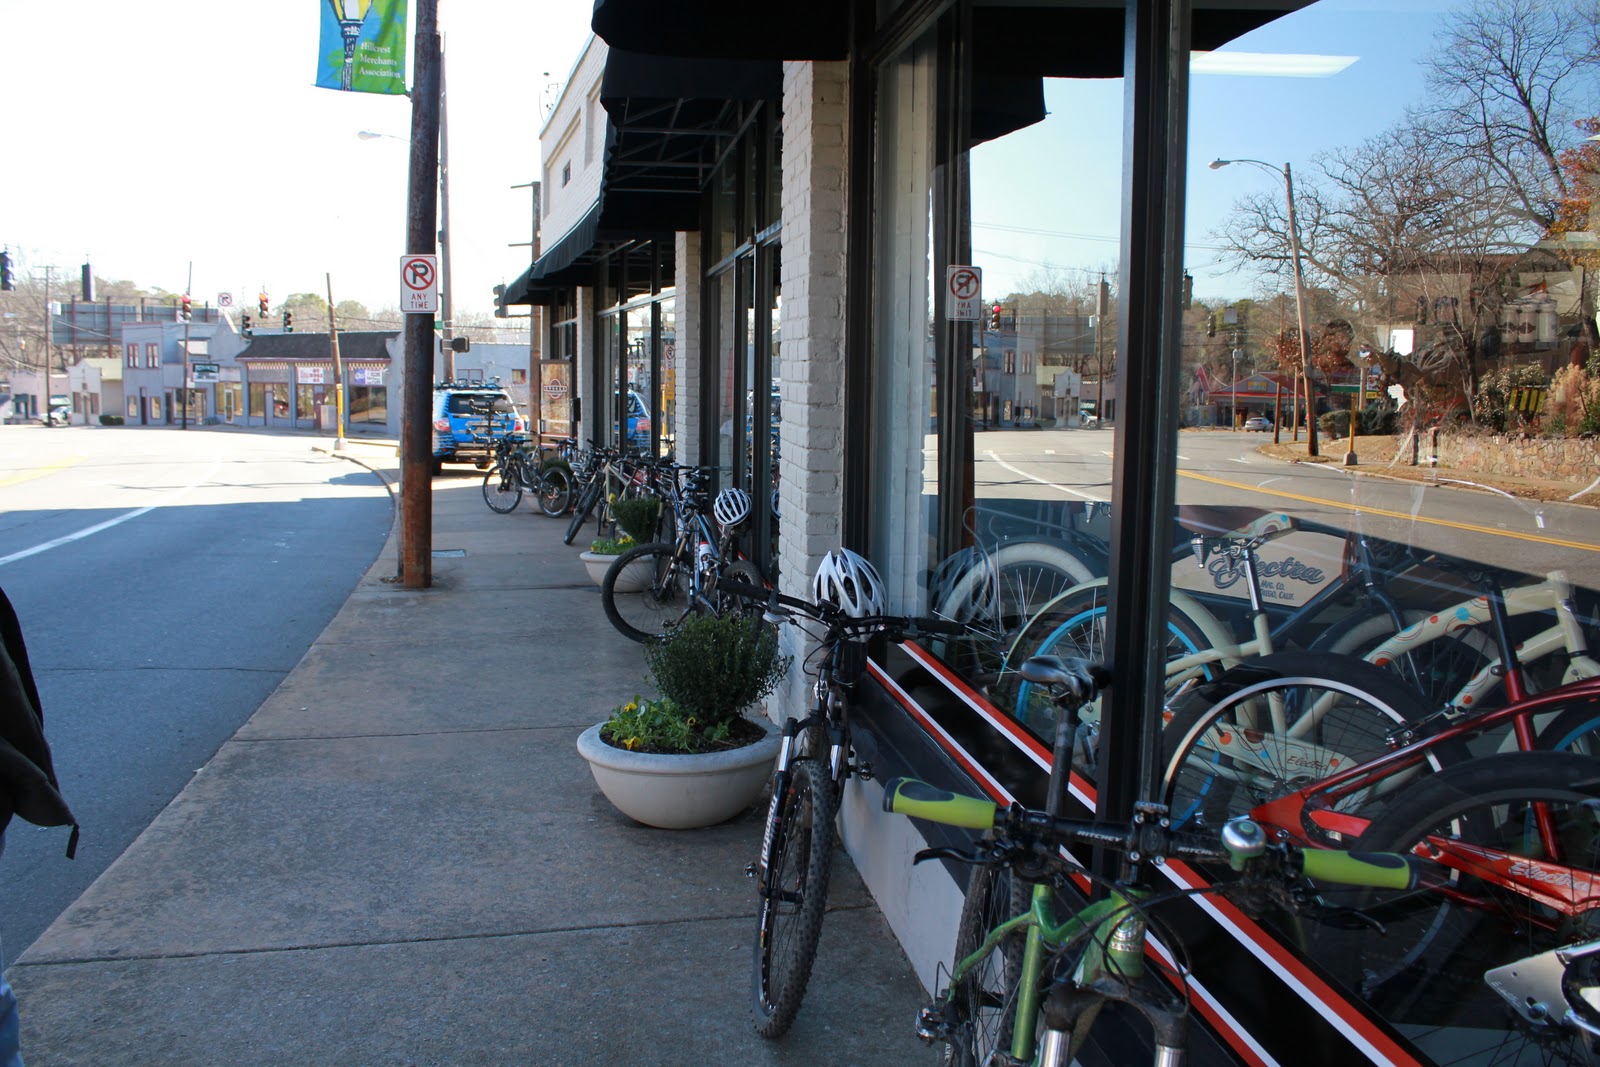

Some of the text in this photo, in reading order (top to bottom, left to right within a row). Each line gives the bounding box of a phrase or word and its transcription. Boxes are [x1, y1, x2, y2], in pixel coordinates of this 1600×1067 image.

[360, 41, 391, 53] Hillcrest
[359, 53, 398, 66] Merchants
[358, 67, 401, 79] Association
[411, 293, 428, 301] ANY
[410, 301, 428, 309] TIME
[1287, 756, 1328, 770] Electra
[1076, 830, 1123, 842] RITCHEY
[1509, 862, 1592, 890] Electra
